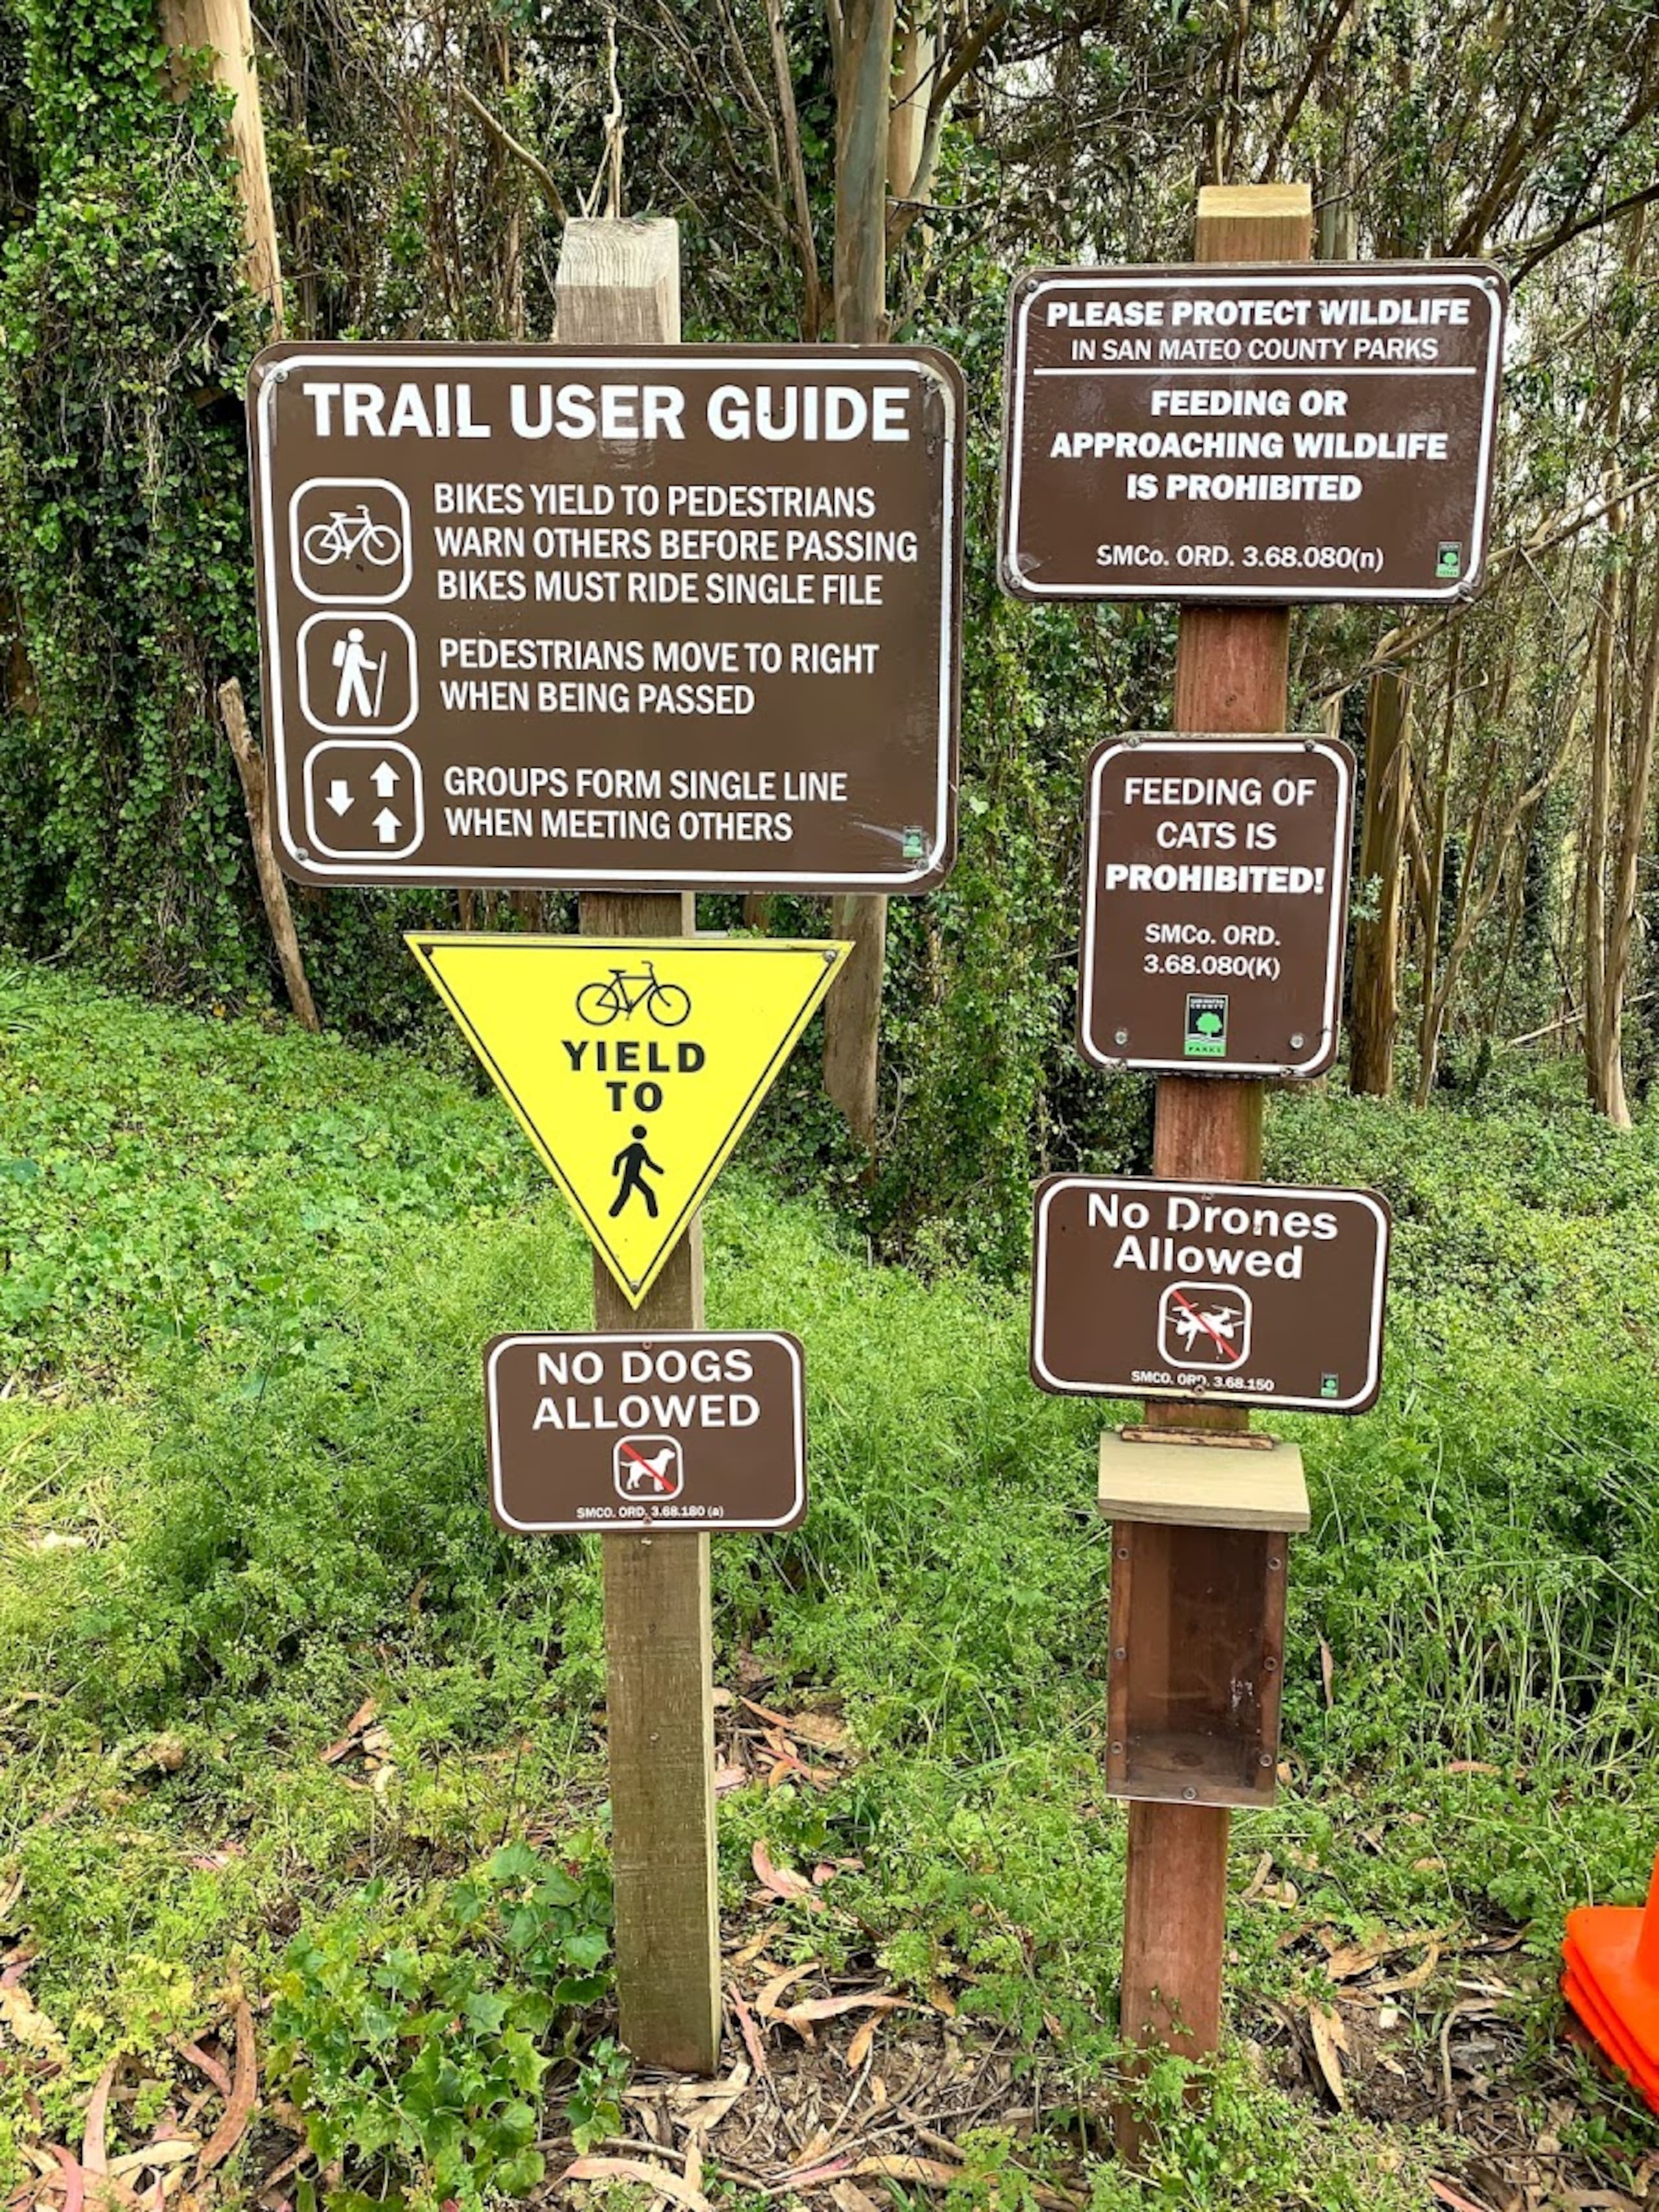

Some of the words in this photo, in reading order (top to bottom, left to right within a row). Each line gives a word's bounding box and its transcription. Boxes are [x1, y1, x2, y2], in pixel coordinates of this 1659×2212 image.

[1047, 301, 1164, 327] PLEASE
[1172, 300, 1311, 326] PROTECT
[1319, 299, 1470, 325] WILDLIFE
[1073, 340, 1095, 360] IN
[1102, 340, 1151, 360] SAN
[1159, 339, 1241, 360] MATEO
[1248, 338, 1348, 360] COUNTY
[1354, 338, 1438, 360] PARKS
[303, 383, 491, 437] TRAIL
[511, 384, 684, 439] USER
[708, 385, 909, 441] GUIDE
[1152, 390, 1290, 415] FEEDING
[1299, 390, 1347, 416] OR
[1050, 432, 1283, 458] APPROACHING
[1294, 433, 1448, 460] WILDLIFE
[435, 483, 524, 514] BIKES
[530, 485, 614, 515] YIELD
[621, 485, 658, 516] TO
[669, 486, 875, 518] PEDESTRIANS
[1128, 474, 1158, 500] IS
[1166, 474, 1362, 500] PROHIBITED
[435, 527, 524, 557] WARN
[534, 528, 651, 559] OTHERS
[660, 530, 778, 561] BEFORE
[787, 531, 917, 562] PASSING
[1097, 545, 1169, 566] SMCo.
[1177, 546, 1234, 566] ORD.
[1242, 546, 1383, 572] 3.68.080(n)
[438, 570, 526, 600] BIKES
[535, 571, 621, 601] MUST
[629, 573, 699, 603] RIDE
[706, 573, 815, 603] SINGLE
[824, 575, 882, 605] FILE
[441, 638, 644, 671] PEDESTRIANS
[653, 642, 739, 671] MOVE
[744, 643, 782, 673] TO
[791, 644, 879, 673] RIGHT
[440, 681, 529, 710] WHEN
[539, 682, 629, 712] BEING
[639, 684, 754, 714] PASSED
[445, 767, 568, 797] GROUPS
[577, 769, 660, 798] FORM
[670, 771, 776, 800] SINGLE
[785, 772, 847, 800] LINE
[1125, 778, 1261, 806] FEEDING
[1273, 779, 1316, 806] OF
[445, 808, 532, 837] WHEN
[542, 809, 669, 839] MEETING
[679, 811, 793, 841] OTHERS
[1157, 822, 1236, 848] CATS
[1247, 822, 1276, 849] IS
[1106, 865, 1325, 893] PROHIBITED!
[1146, 924, 1216, 944] SMCo.
[1224, 926, 1280, 946] ORD.
[1144, 954, 1280, 981] 3.68.080(K)
[562, 1041, 704, 1073] YIELD
[606, 1082, 662, 1112] TO
[1089, 1193, 1149, 1228] No
[1168, 1197, 1337, 1239] Drones
[1113, 1235, 1302, 1279] Allowed
[539, 1351, 603, 1384] NO
[622, 1349, 752, 1382] DOGS
[1131, 1371, 1174, 1384] SMCO.
[1214, 1377, 1274, 1391] 3.68.150
[533, 1395, 760, 1429] ALLOWED
[577, 1508, 616, 1519] SMCO.
[619, 1506, 647, 1517] ORD.
[651, 1506, 705, 1517] 3.68.180
[708, 1506, 723, 1518] (a)
